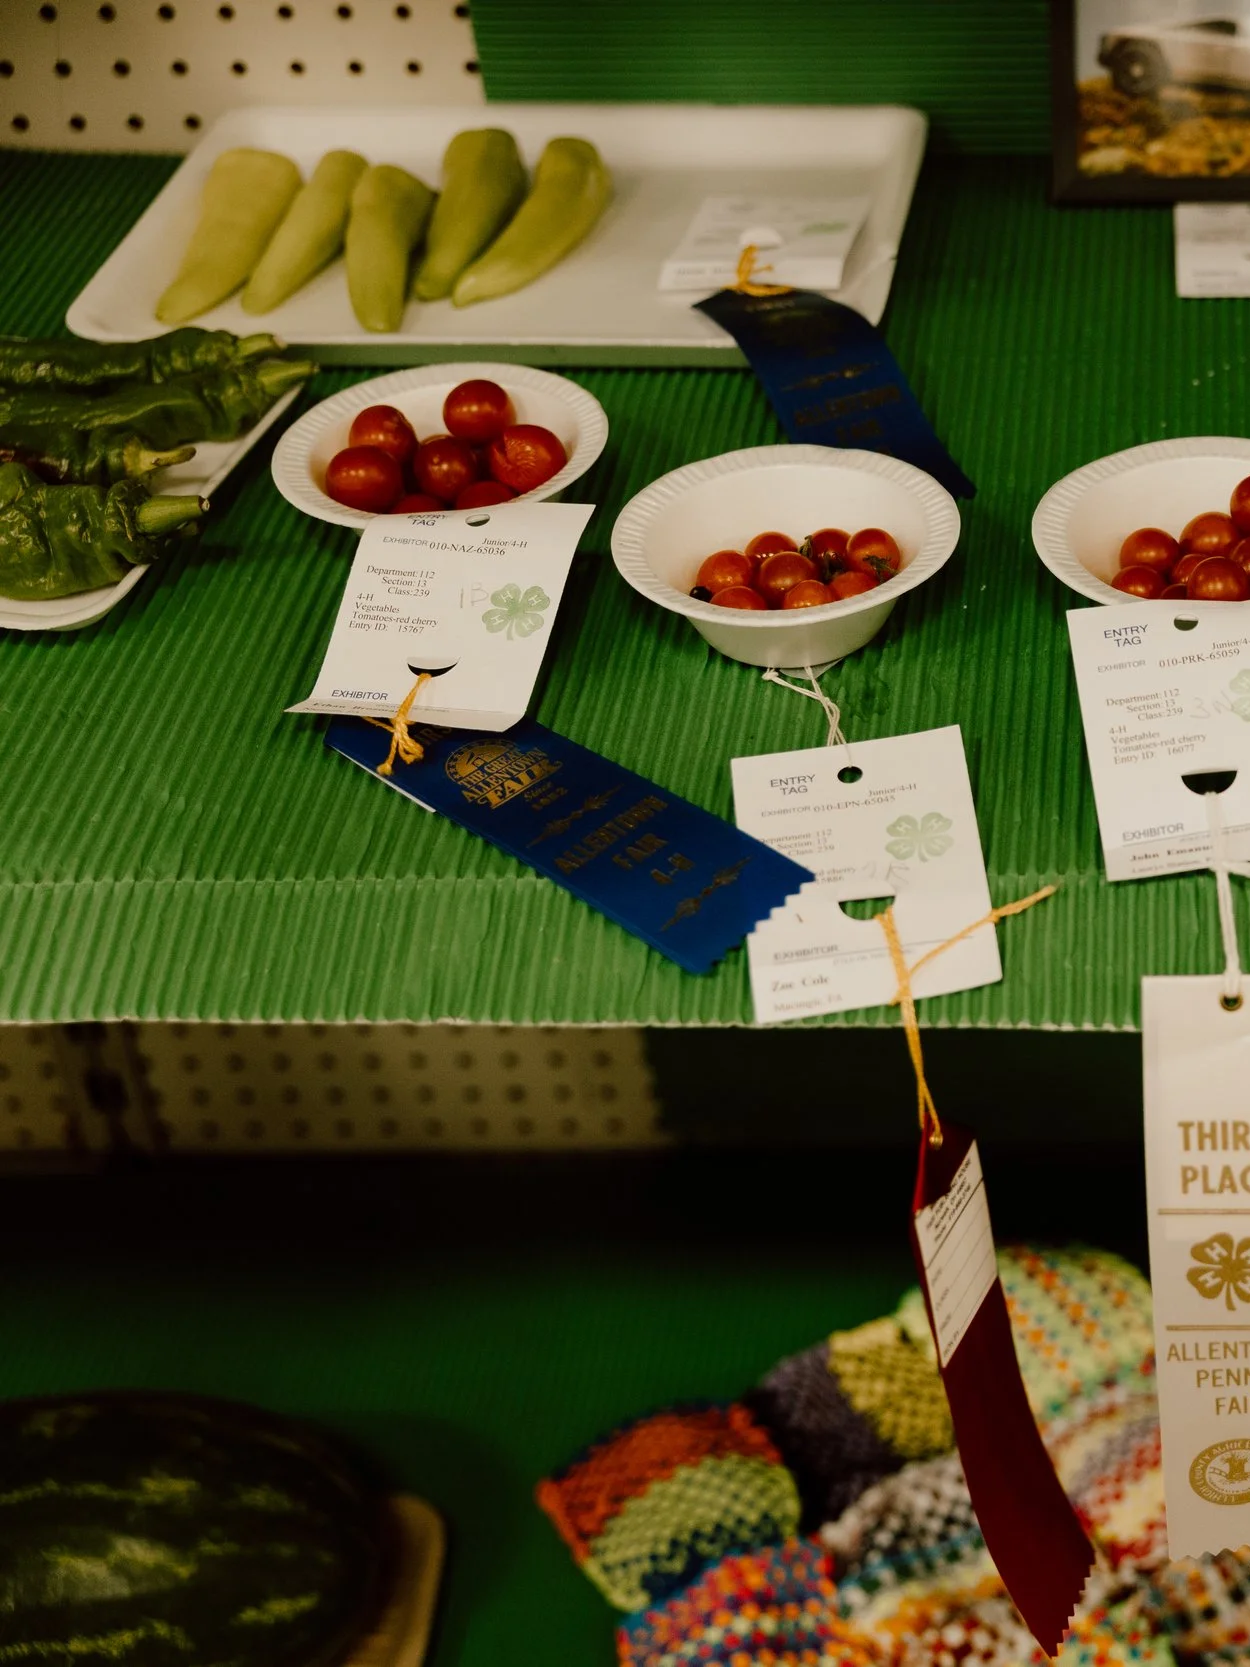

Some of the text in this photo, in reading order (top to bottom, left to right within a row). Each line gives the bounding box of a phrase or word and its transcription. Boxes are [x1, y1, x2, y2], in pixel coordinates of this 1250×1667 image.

[383, 536, 506, 556] EXHIBITOR 010-NAZ-65036
[482, 538, 528, 548] Junior/4-H
[357, 593, 373, 601] 4-H
[355, 602, 400, 614] Vegetables
[352, 611, 438, 627] Tomatoes-red cherry
[349, 621, 424, 634] Entry ID: 15767
[1104, 624, 1148, 639] ENTRY
[1113, 635, 1142, 648] TAG
[1097, 649, 1241, 673] EXHIBITOR 010-PRK-65059
[332, 690, 388, 701] EXHIBITOR
[1109, 725, 1127, 735] 4-H
[1110, 731, 1160, 745] Vegetables
[1112, 733, 1207, 755] Tomatoes-red cherry
[1113, 752, 1140, 765] Entry
[1167, 744, 1195, 756] 16077
[459, 770, 488, 788] THE
[461, 745, 548, 803] ALLENTOWN
[770, 774, 816, 788] ENTRY
[476, 757, 563, 810] FAIR
[779, 785, 808, 796] TAG
[761, 806, 811, 818] EXHIBITOR
[553, 793, 669, 875] ALLENTOWN
[1122, 823, 1185, 842] EXHIBITOR
[611, 830, 669, 871] FAIR
[773, 944, 838, 961] EXHIBITOR
